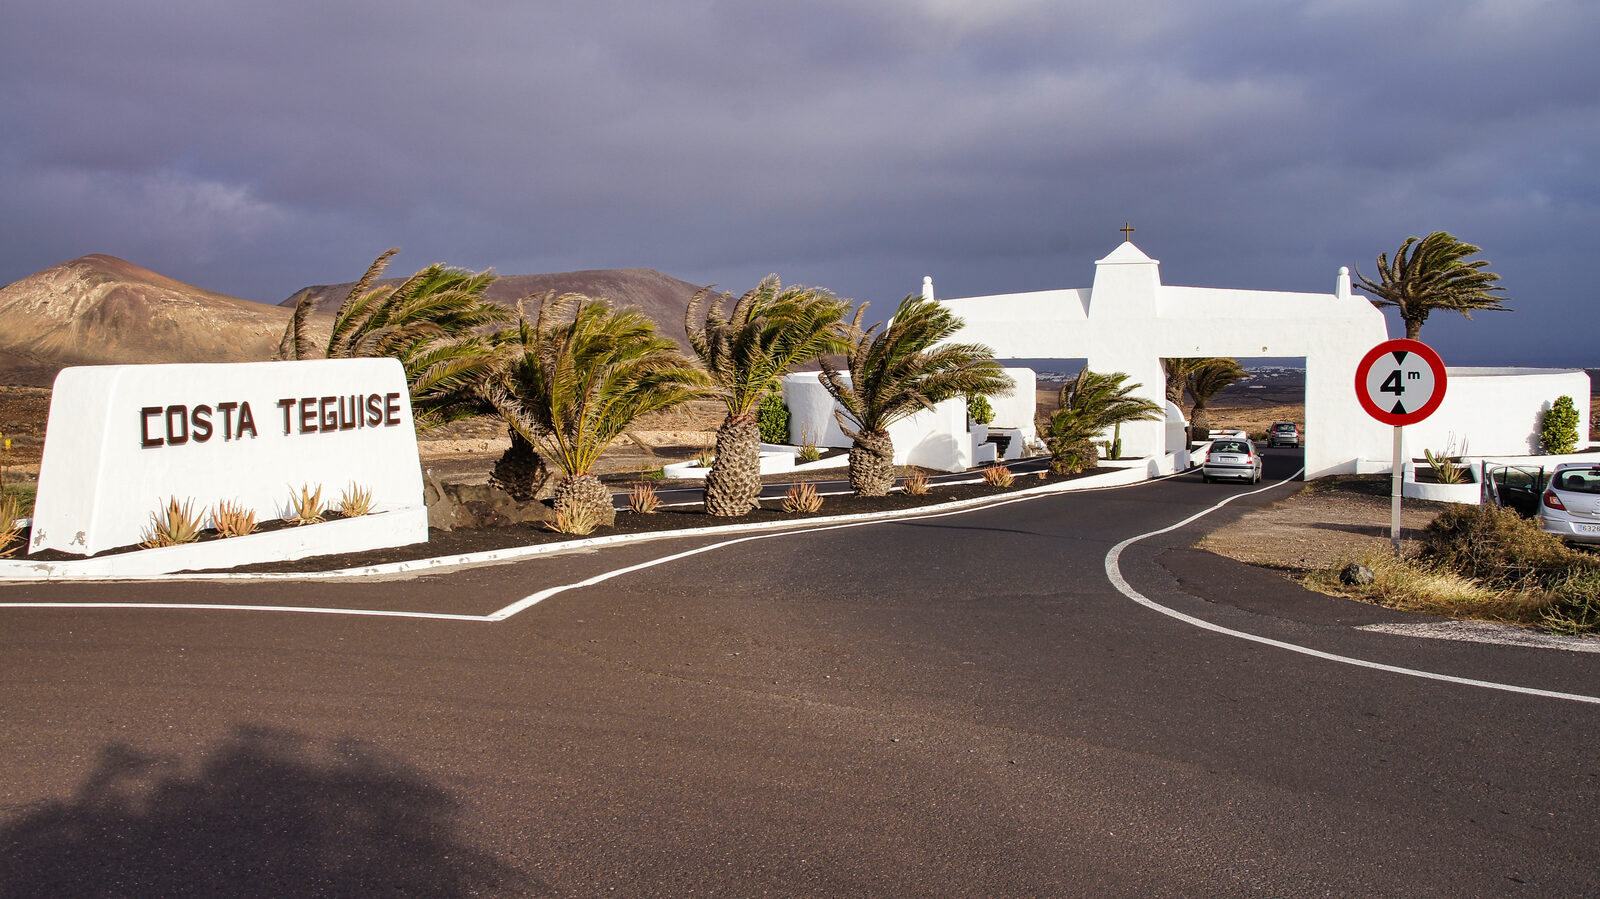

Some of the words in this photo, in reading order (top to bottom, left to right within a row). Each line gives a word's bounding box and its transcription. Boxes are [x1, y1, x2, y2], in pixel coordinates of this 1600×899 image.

[1380, 370, 1405, 396] 4
[1408, 371, 1420, 380] m
[140, 401, 258, 448] COSTA
[278, 393, 401, 435] TEGUISE
